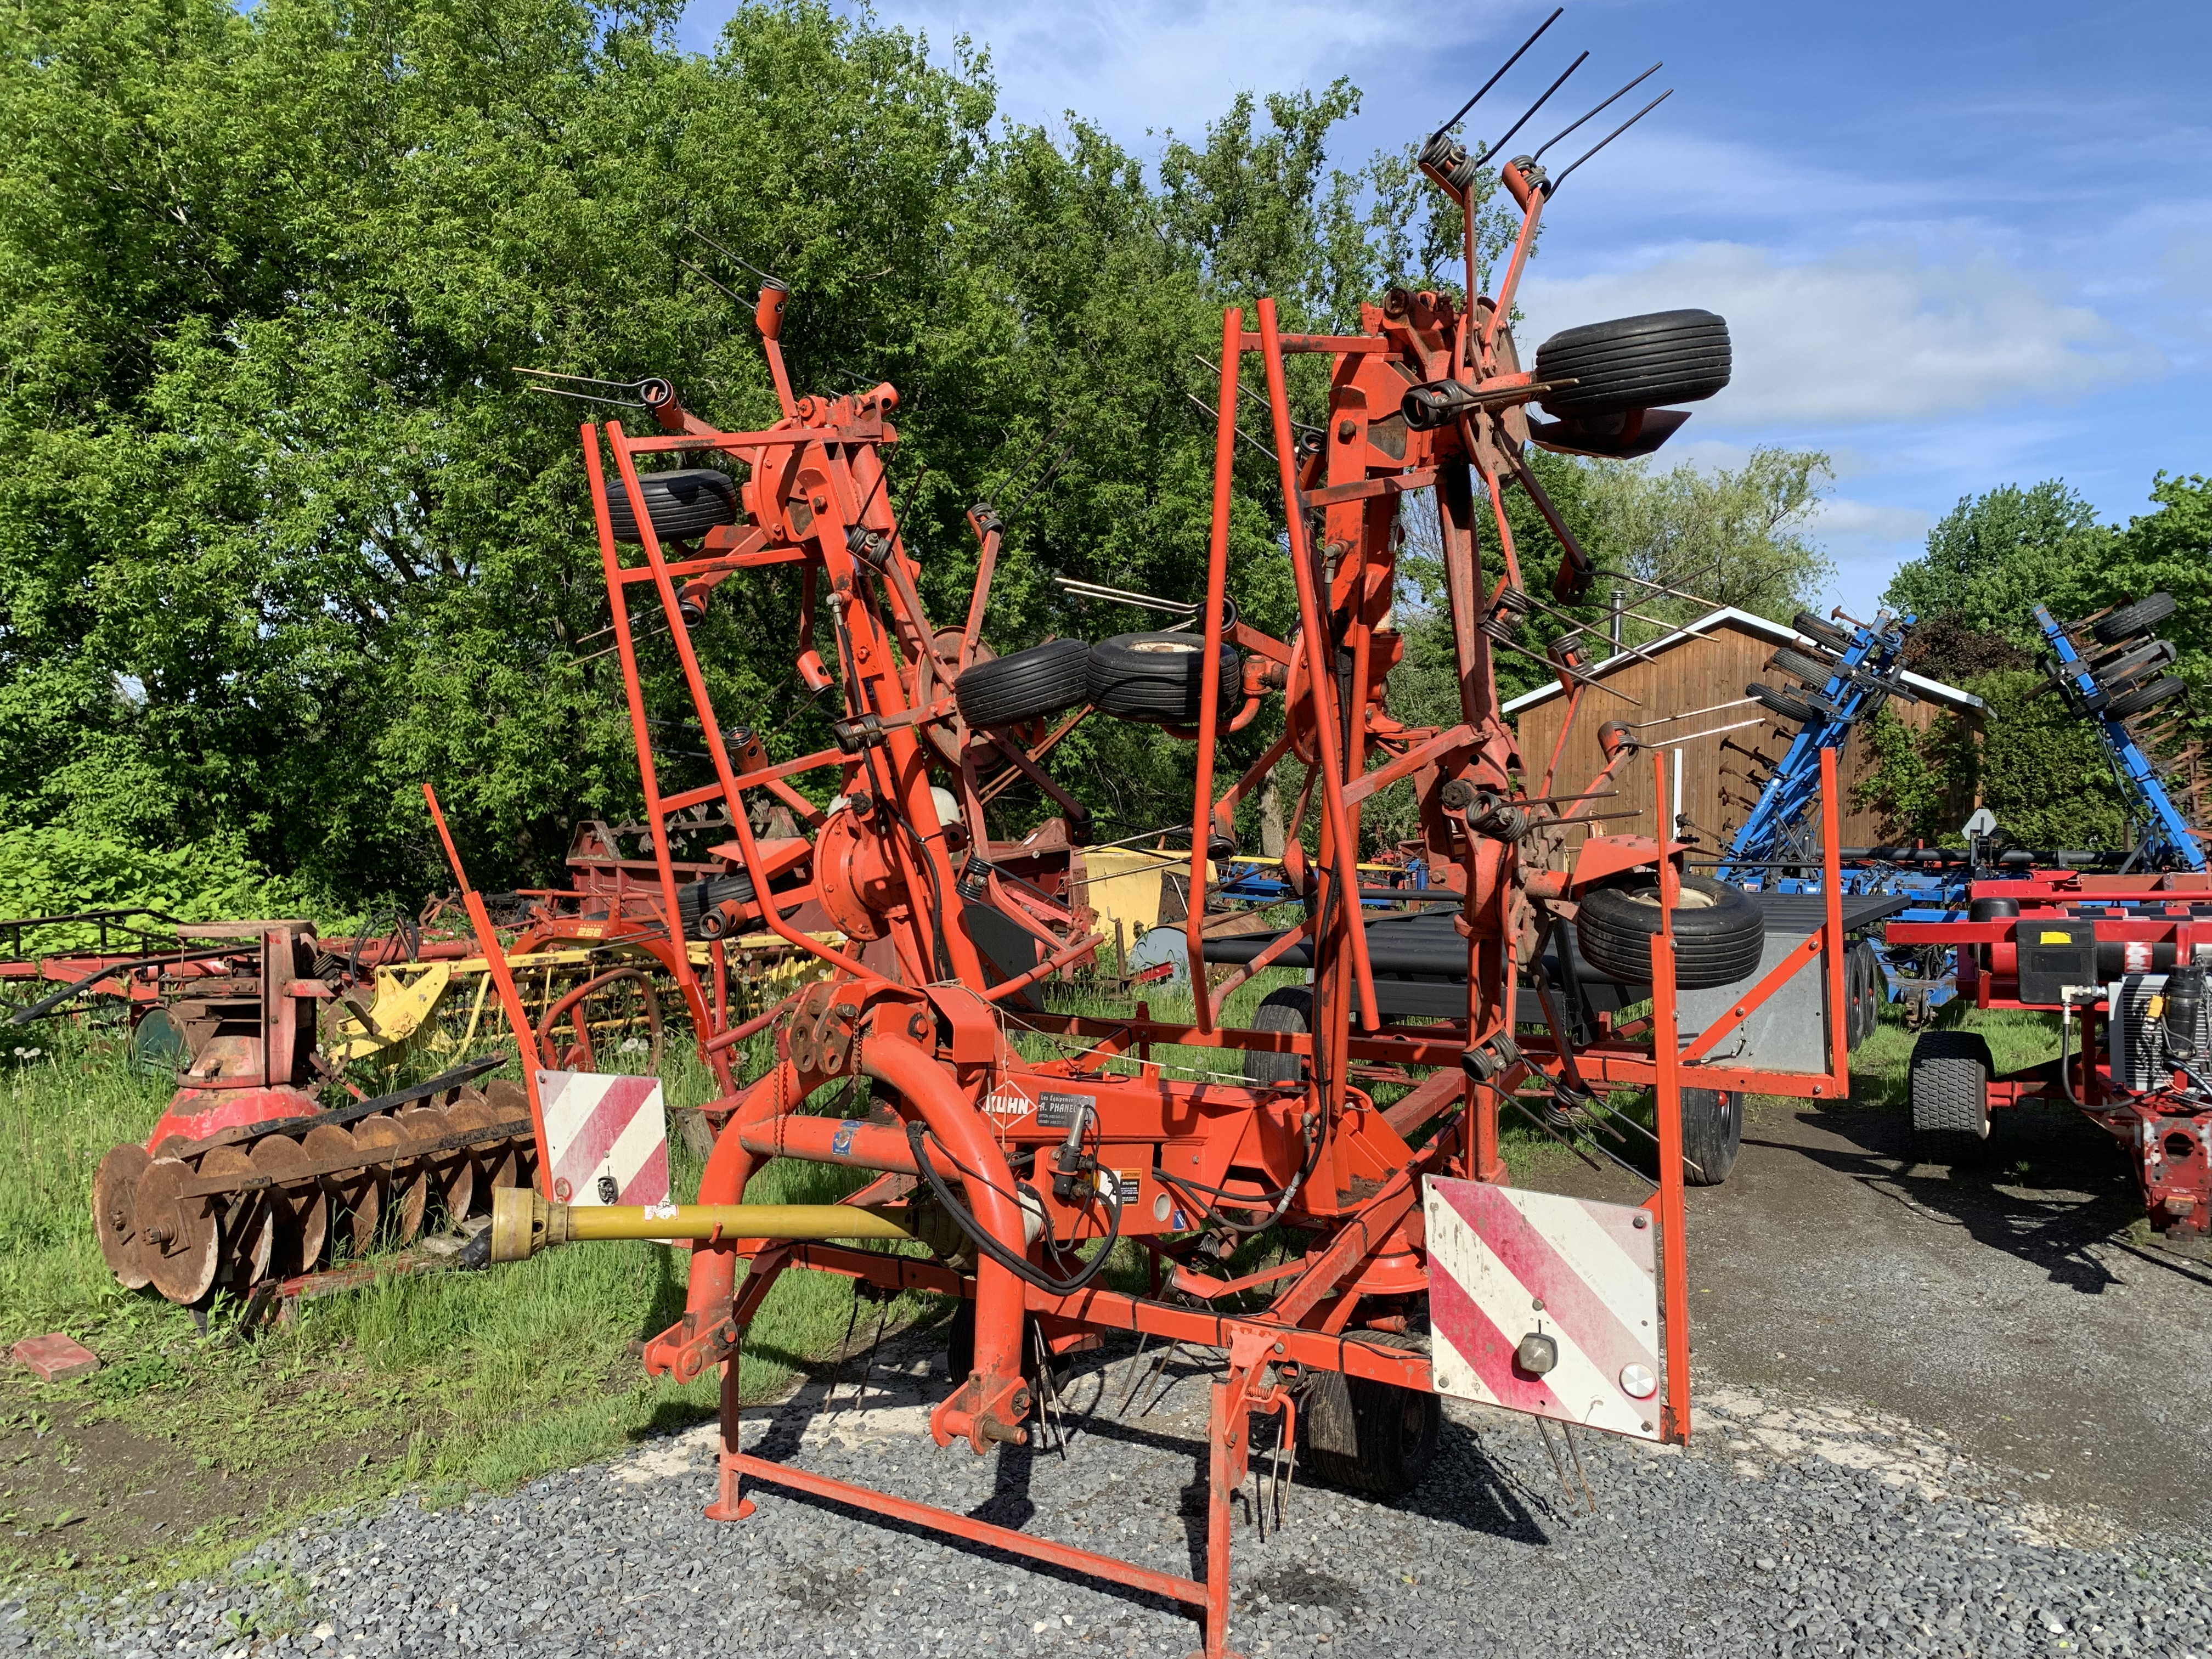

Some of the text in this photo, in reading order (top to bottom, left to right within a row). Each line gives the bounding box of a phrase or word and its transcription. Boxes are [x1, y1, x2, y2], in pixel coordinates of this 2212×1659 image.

[577, 927, 602, 937] 258
[985, 1095, 1028, 1115] KUHN
[1040, 1102, 1046, 1111] A.
